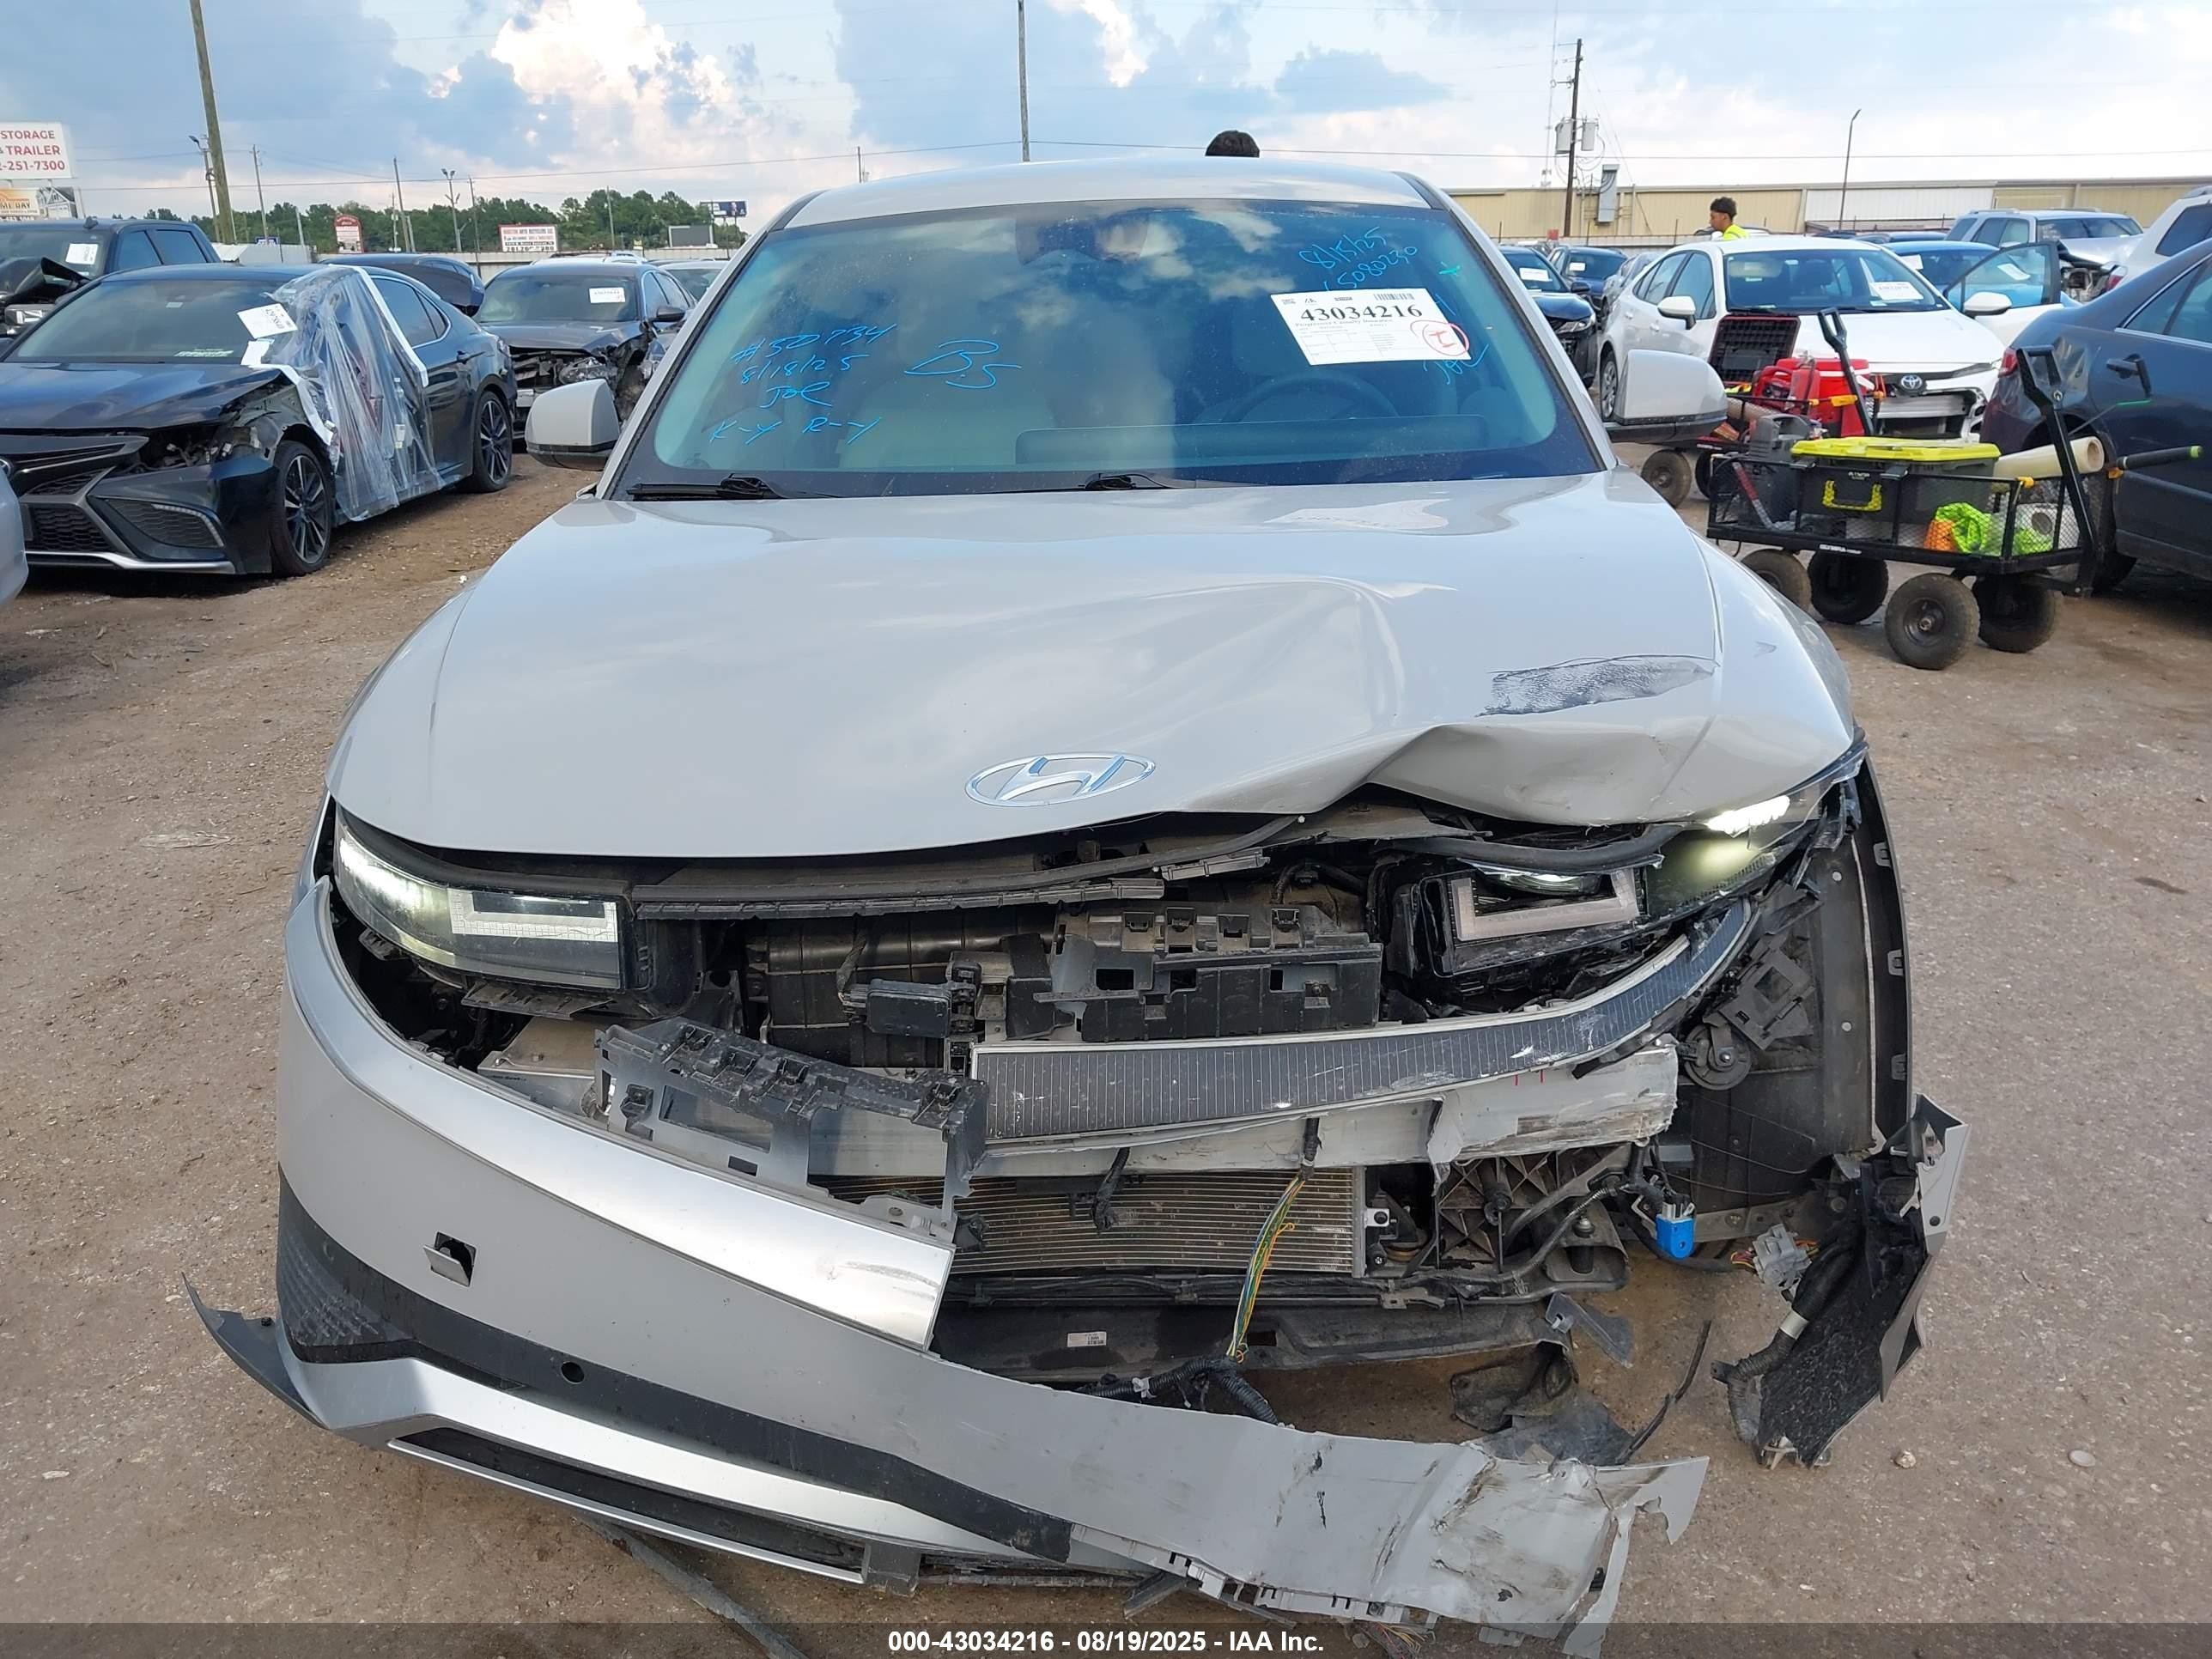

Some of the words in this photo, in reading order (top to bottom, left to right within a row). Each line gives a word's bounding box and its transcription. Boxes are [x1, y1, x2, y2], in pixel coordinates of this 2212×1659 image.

[0, 131, 55, 139] STORAGE
[5, 145, 61, 155] TRAILER
[0, 160, 65, 171] -251-7300
[1300, 303, 1424, 321] 43034216
